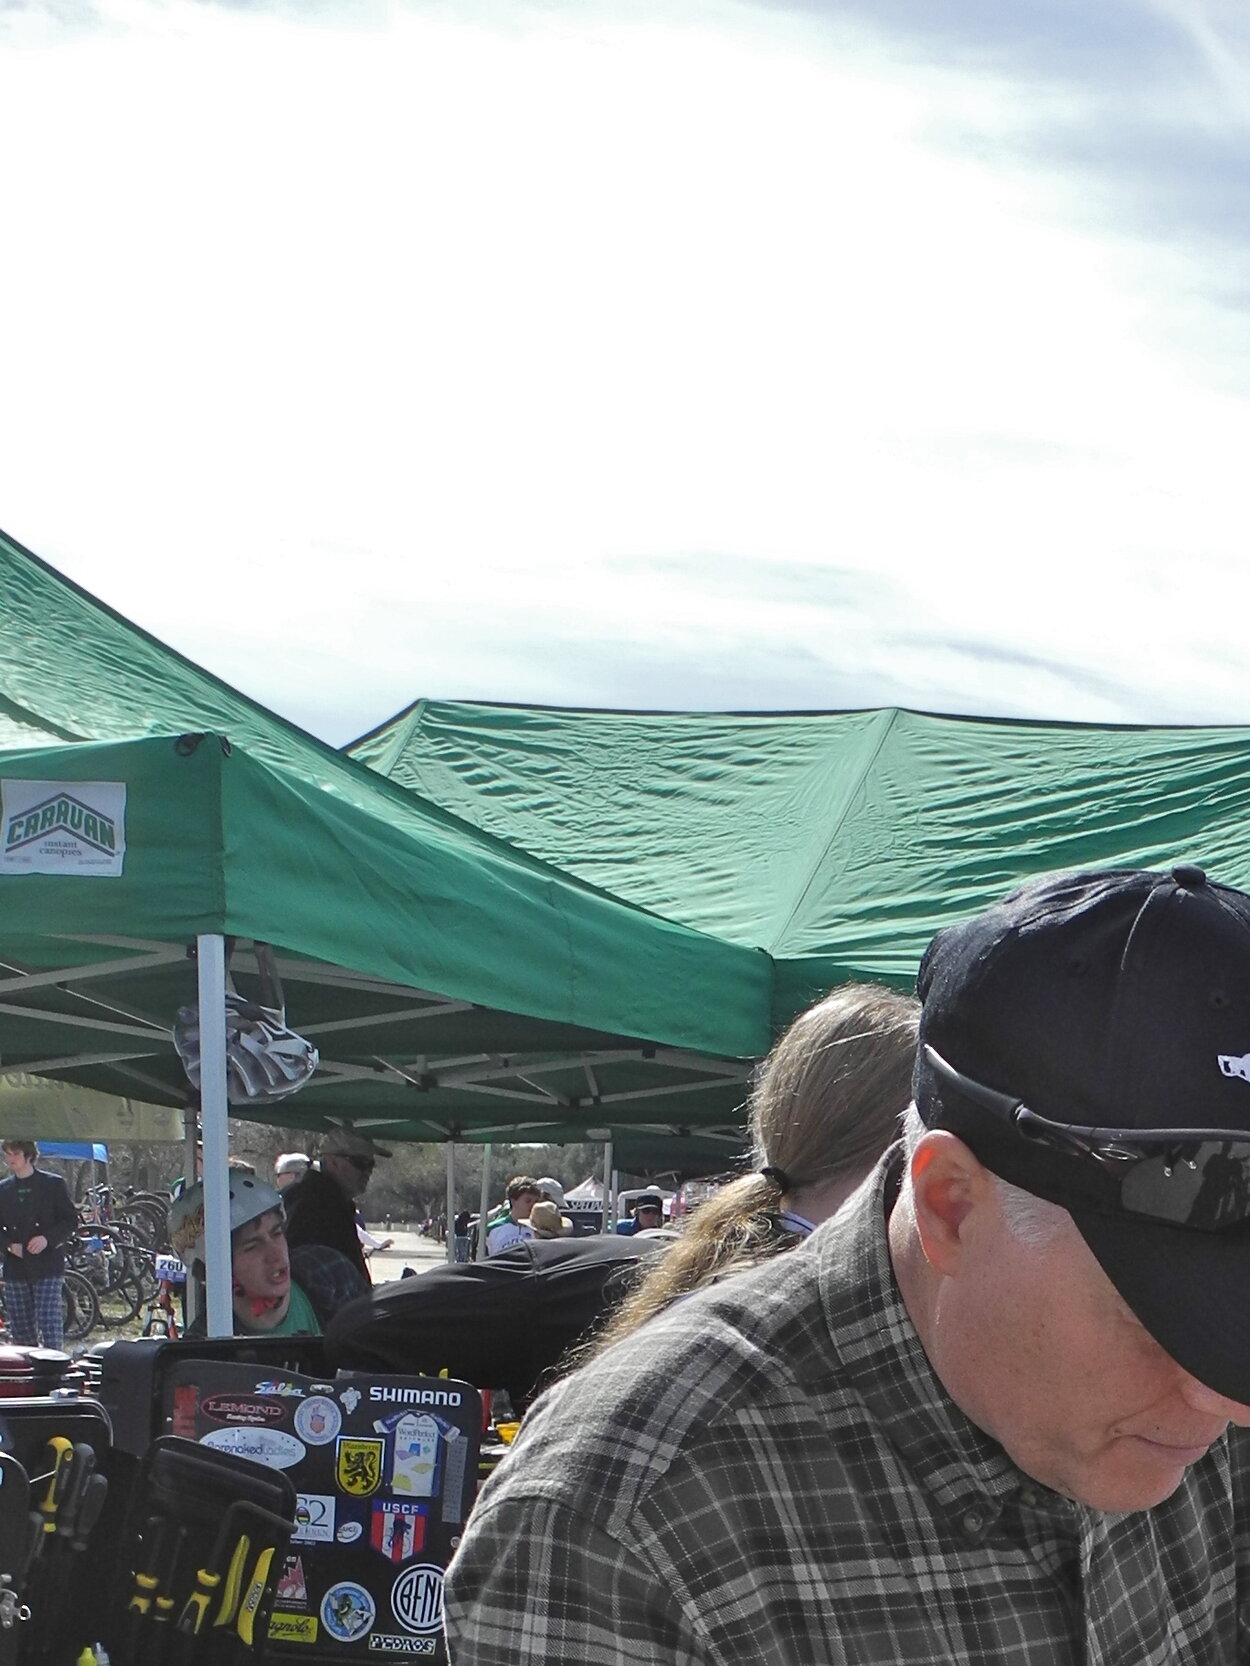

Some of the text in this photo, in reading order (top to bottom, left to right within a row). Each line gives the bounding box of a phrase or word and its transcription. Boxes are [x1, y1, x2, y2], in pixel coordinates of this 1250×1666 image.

[7, 799, 116, 851] CARAVAN
[44, 840, 77, 848] instant
[40, 847, 82, 858] canopies
[570, 1199, 605, 1212] SPECIA
[159, 1260, 183, 1272] 260
[254, 1381, 306, 1397] Salsa
[369, 1387, 461, 1407] SHIMANO
[382, 1502, 419, 1514] USCF
